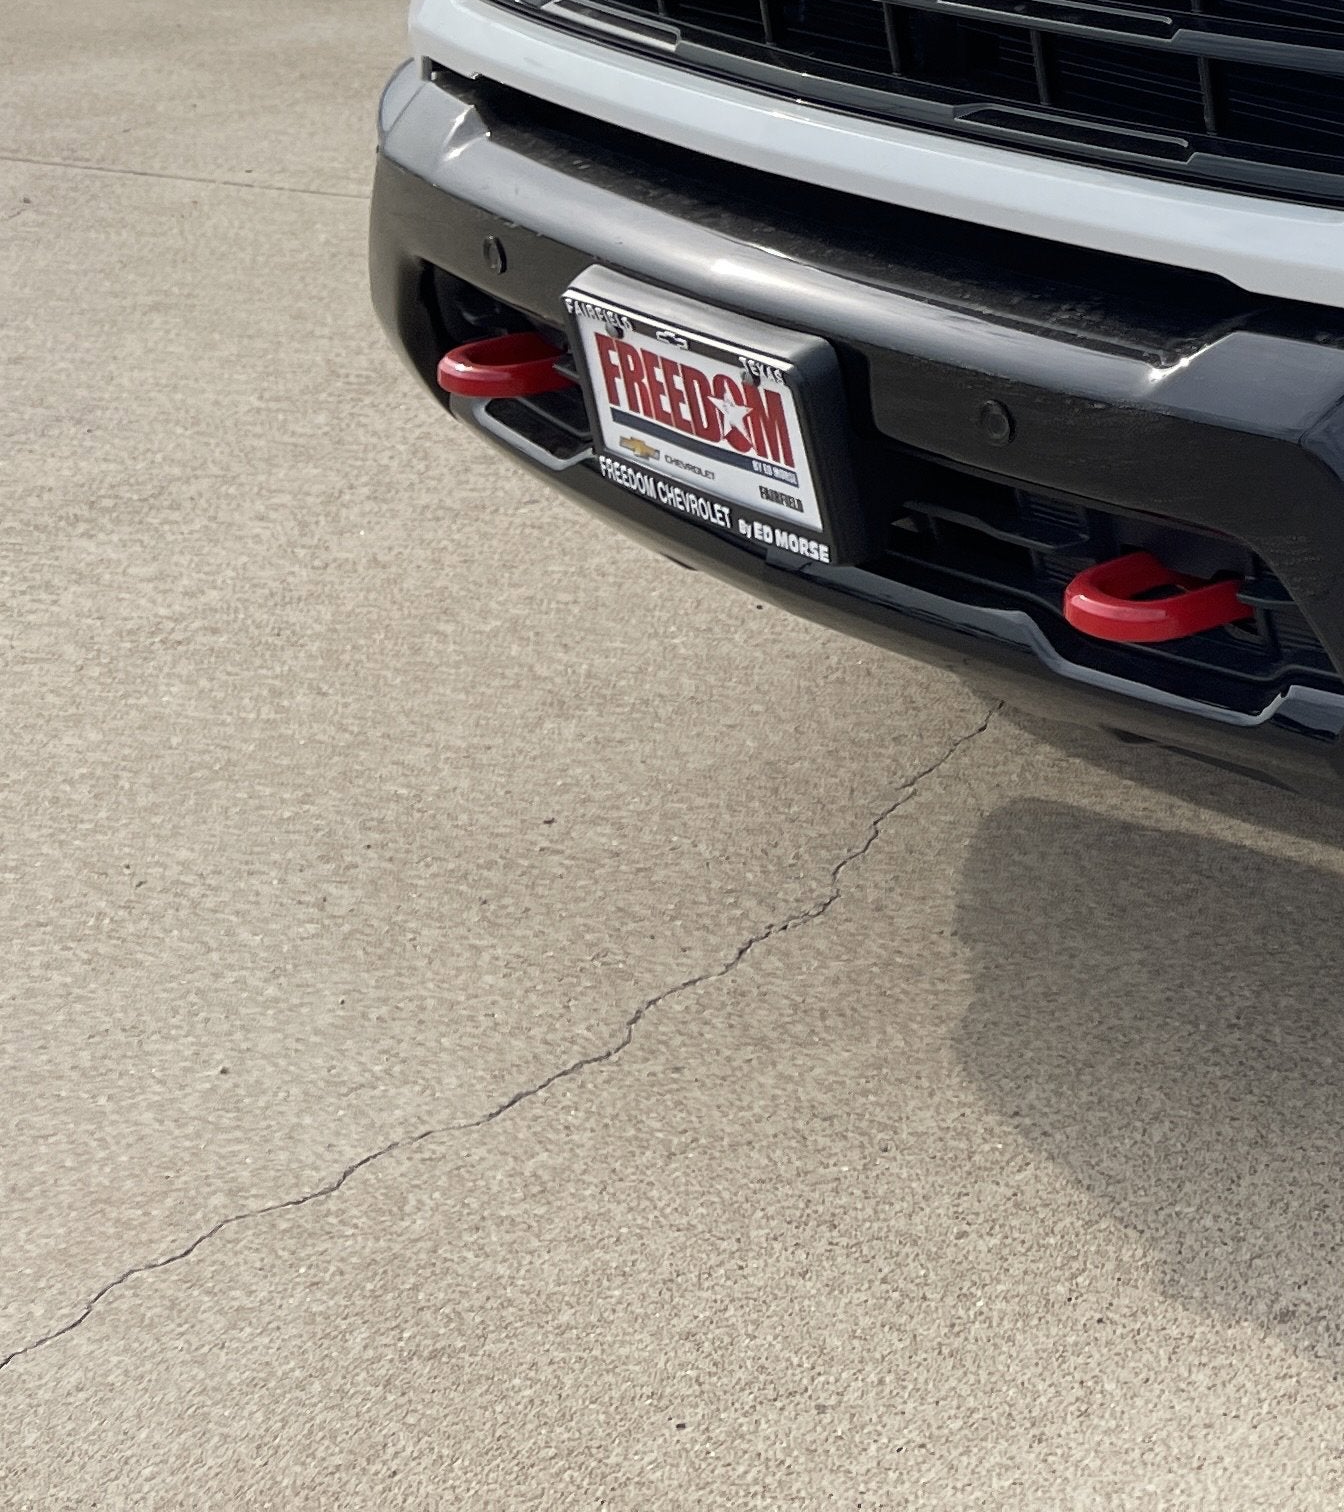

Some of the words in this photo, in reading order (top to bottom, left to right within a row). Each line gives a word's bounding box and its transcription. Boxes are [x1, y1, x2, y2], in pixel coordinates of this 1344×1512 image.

[564, 298, 634, 332] FAIRFIELD
[738, 356, 786, 385] TEXAS
[594, 331, 796, 469] FREEDOM
[664, 454, 716, 480] CHEVROLET
[599, 455, 658, 500] FREEDOM
[657, 480, 732, 529] CHEVROLET
[753, 521, 773, 545] ED
[775, 528, 831, 564] MORSE
